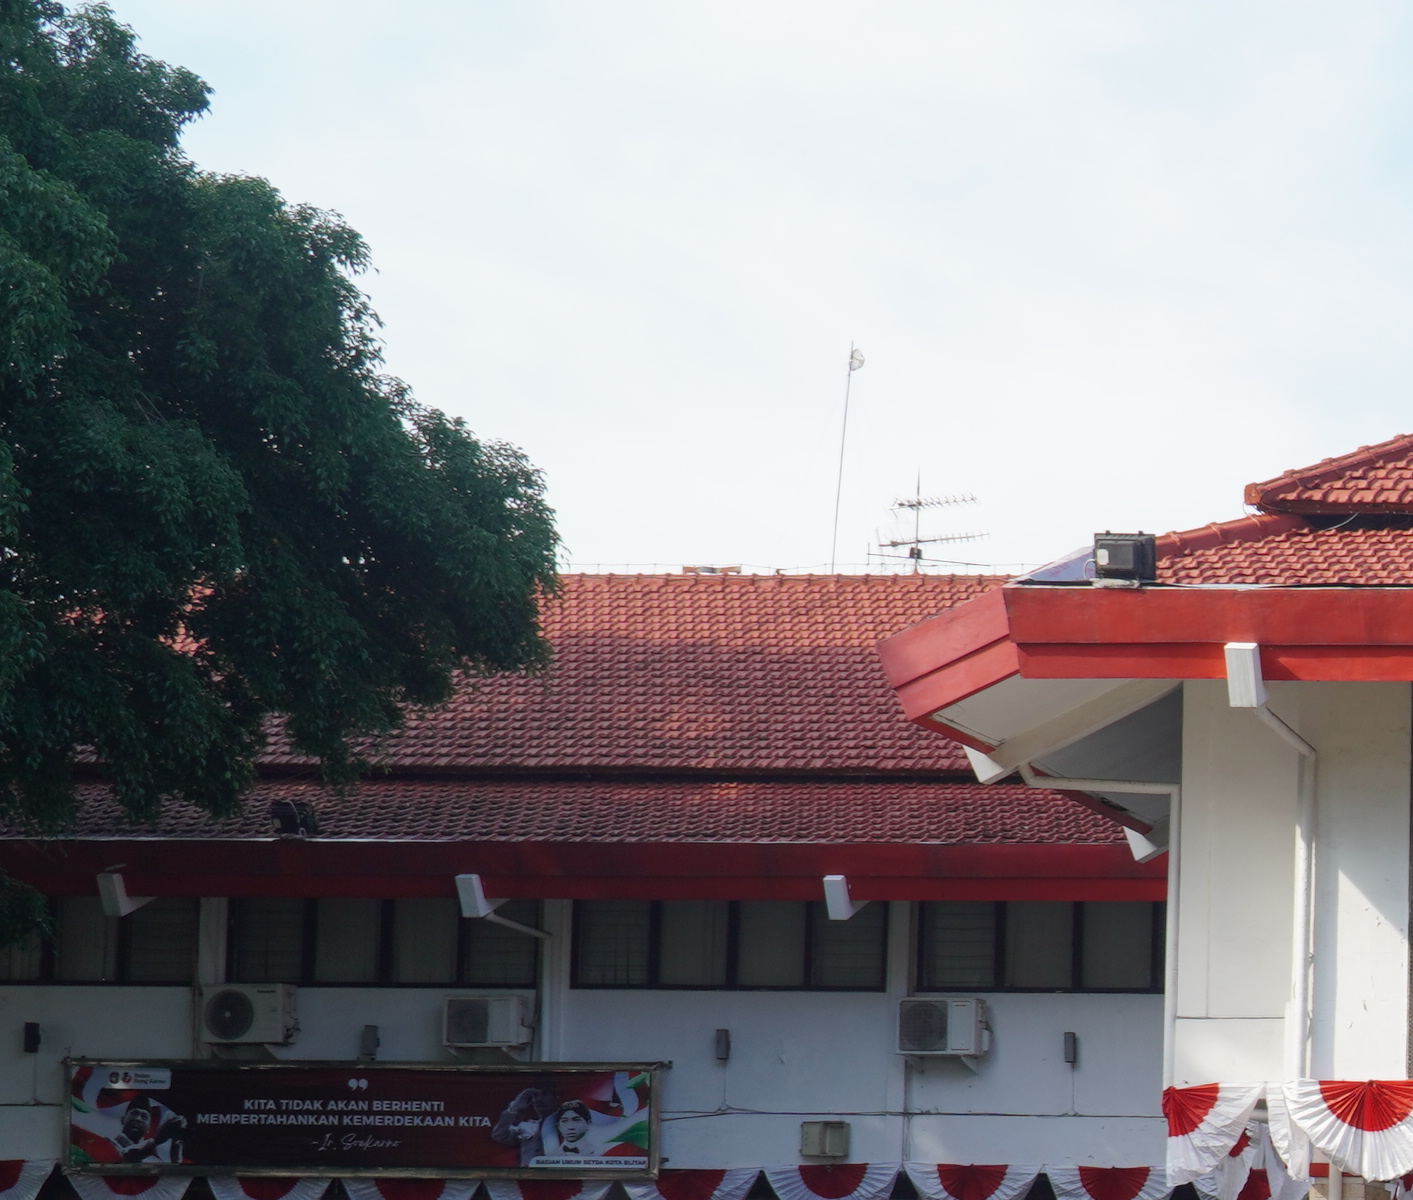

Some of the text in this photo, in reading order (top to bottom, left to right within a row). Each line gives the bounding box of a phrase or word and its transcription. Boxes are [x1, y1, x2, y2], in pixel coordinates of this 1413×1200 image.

[244, 1100, 445, 1112] KITA TIDAK AKAN BERHENTI
[197, 1114, 492, 1127] MEMPERTAHANKAN KEMERDEKAAN KITA
